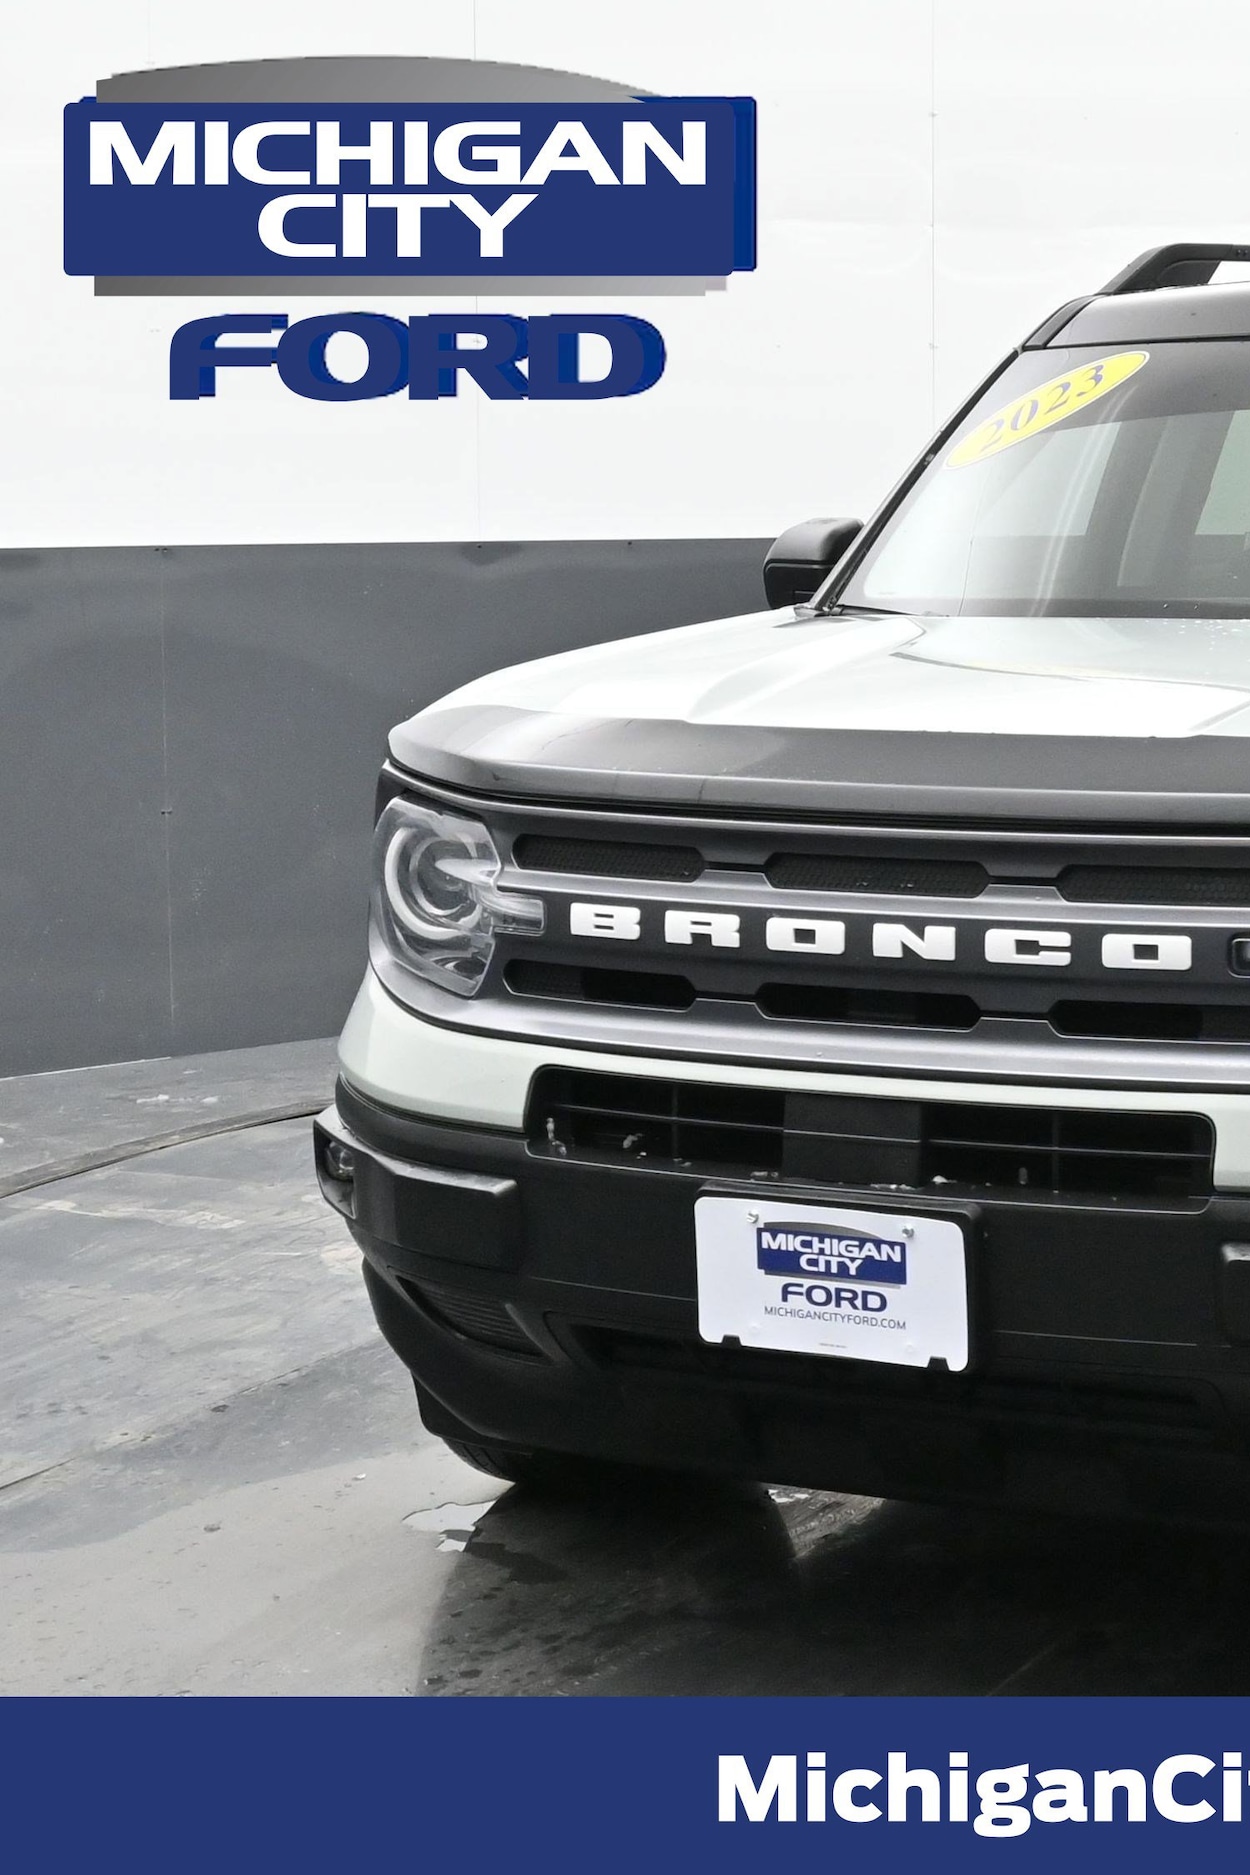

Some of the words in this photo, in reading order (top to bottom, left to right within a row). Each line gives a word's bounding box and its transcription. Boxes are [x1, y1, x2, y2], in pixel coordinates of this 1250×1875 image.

[979, 363, 1105, 453] 2023
[569, 902, 1193, 971] BRONCO
[761, 1232, 901, 1263] MICHIGAN
[799, 1254, 863, 1276] CITY
[781, 1282, 888, 1313] FORD
[764, 1306, 907, 1331] MICHIGANCITYFORD.COM
